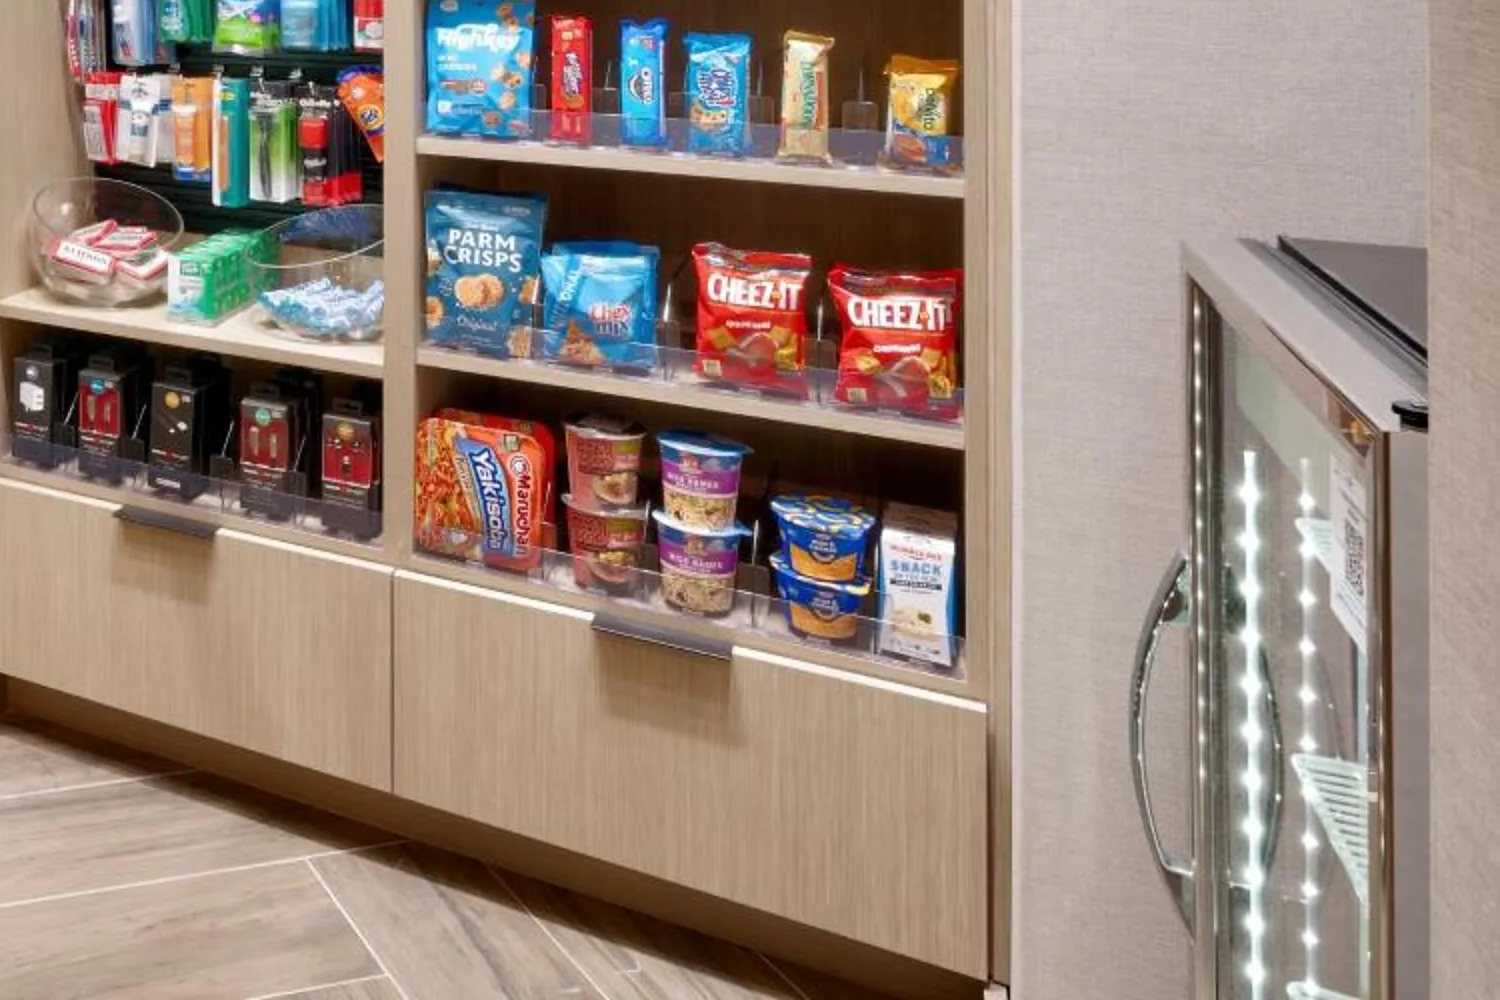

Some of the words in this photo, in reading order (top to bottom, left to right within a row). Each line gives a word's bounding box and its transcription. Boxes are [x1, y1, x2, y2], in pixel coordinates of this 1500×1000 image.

[448, 228, 516, 250] PARM
[444, 246, 523, 273] CRISPS
[707, 272, 803, 310] CHEEZ-IT
[848, 295, 947, 331] CHEEZ-IT
[468, 447, 508, 550] Yakisoba
[516, 474, 531, 555] Maruchan
[891, 560, 942, 576] SNACK
